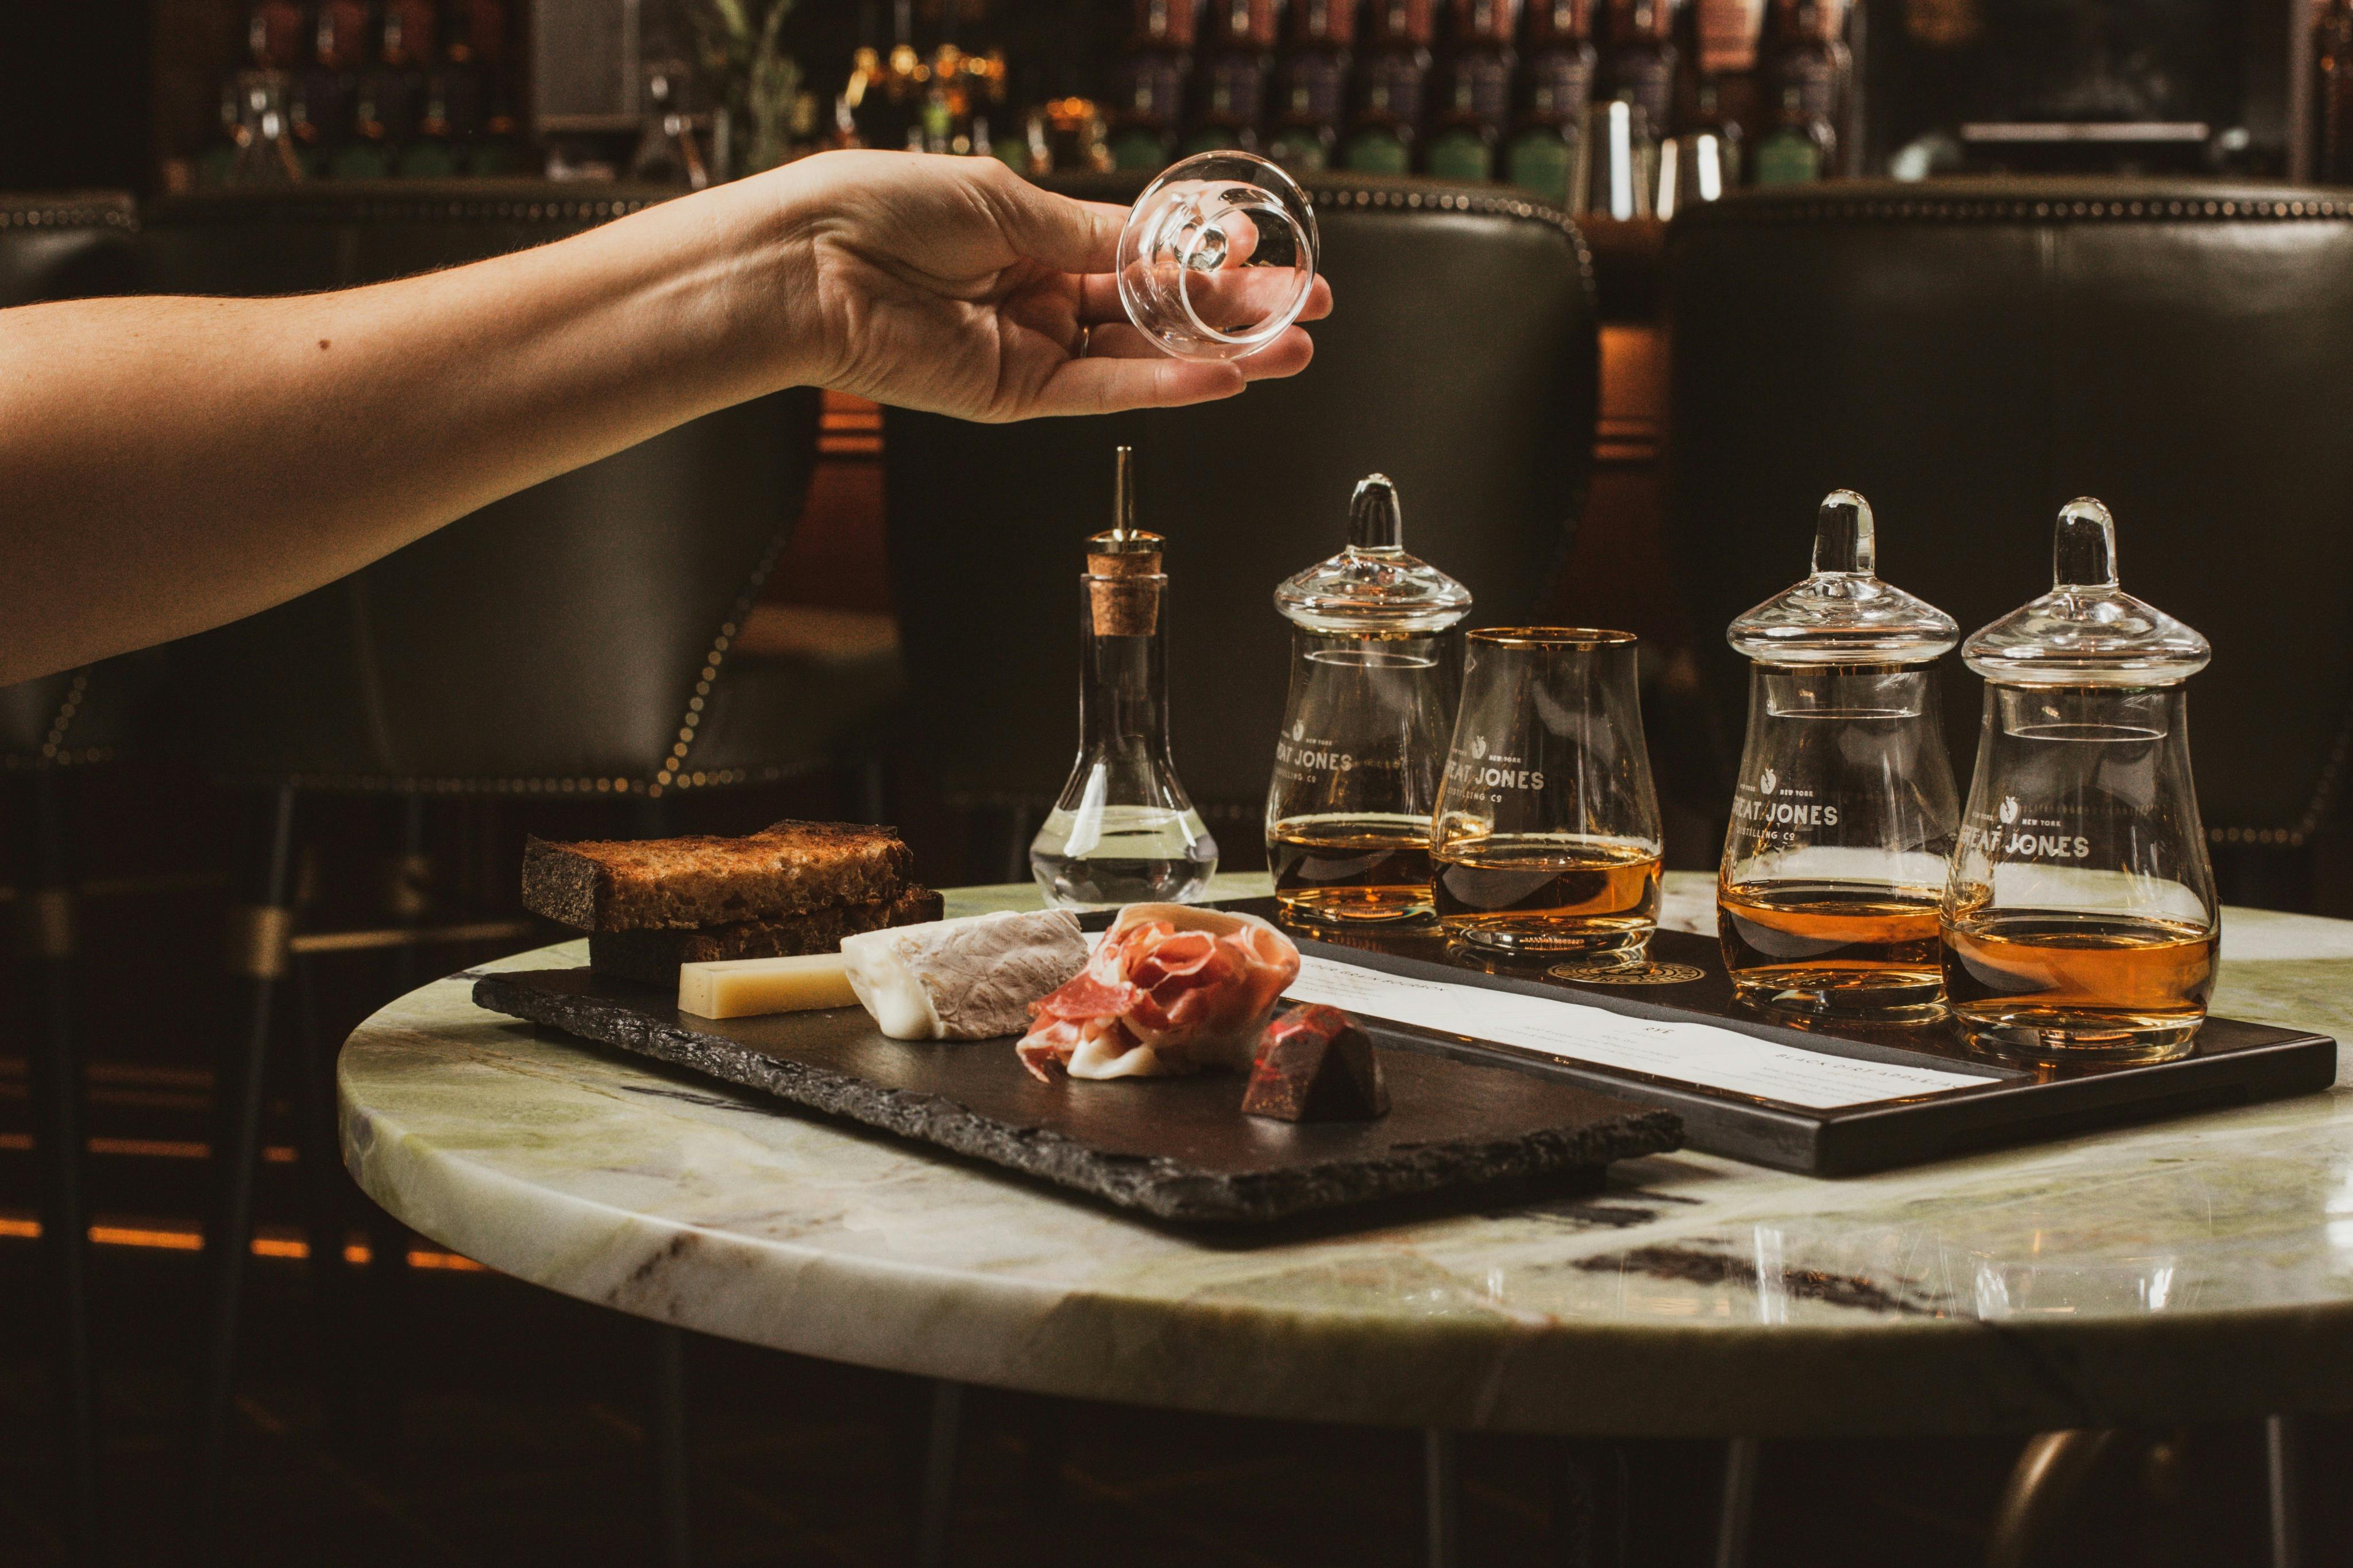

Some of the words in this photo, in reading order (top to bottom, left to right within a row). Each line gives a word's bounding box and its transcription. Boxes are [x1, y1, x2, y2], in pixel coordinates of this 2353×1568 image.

[1295, 750, 1352, 771] JONES
[1475, 767, 1544, 790] JONES
[1766, 803, 1838, 825] JONES
[2005, 833, 2089, 858] JONES
[1776, 1054, 1824, 1065] BLACK
[1833, 1064, 1875, 1072] DIRT
[1878, 1072, 1966, 1089] APPLEJAC
